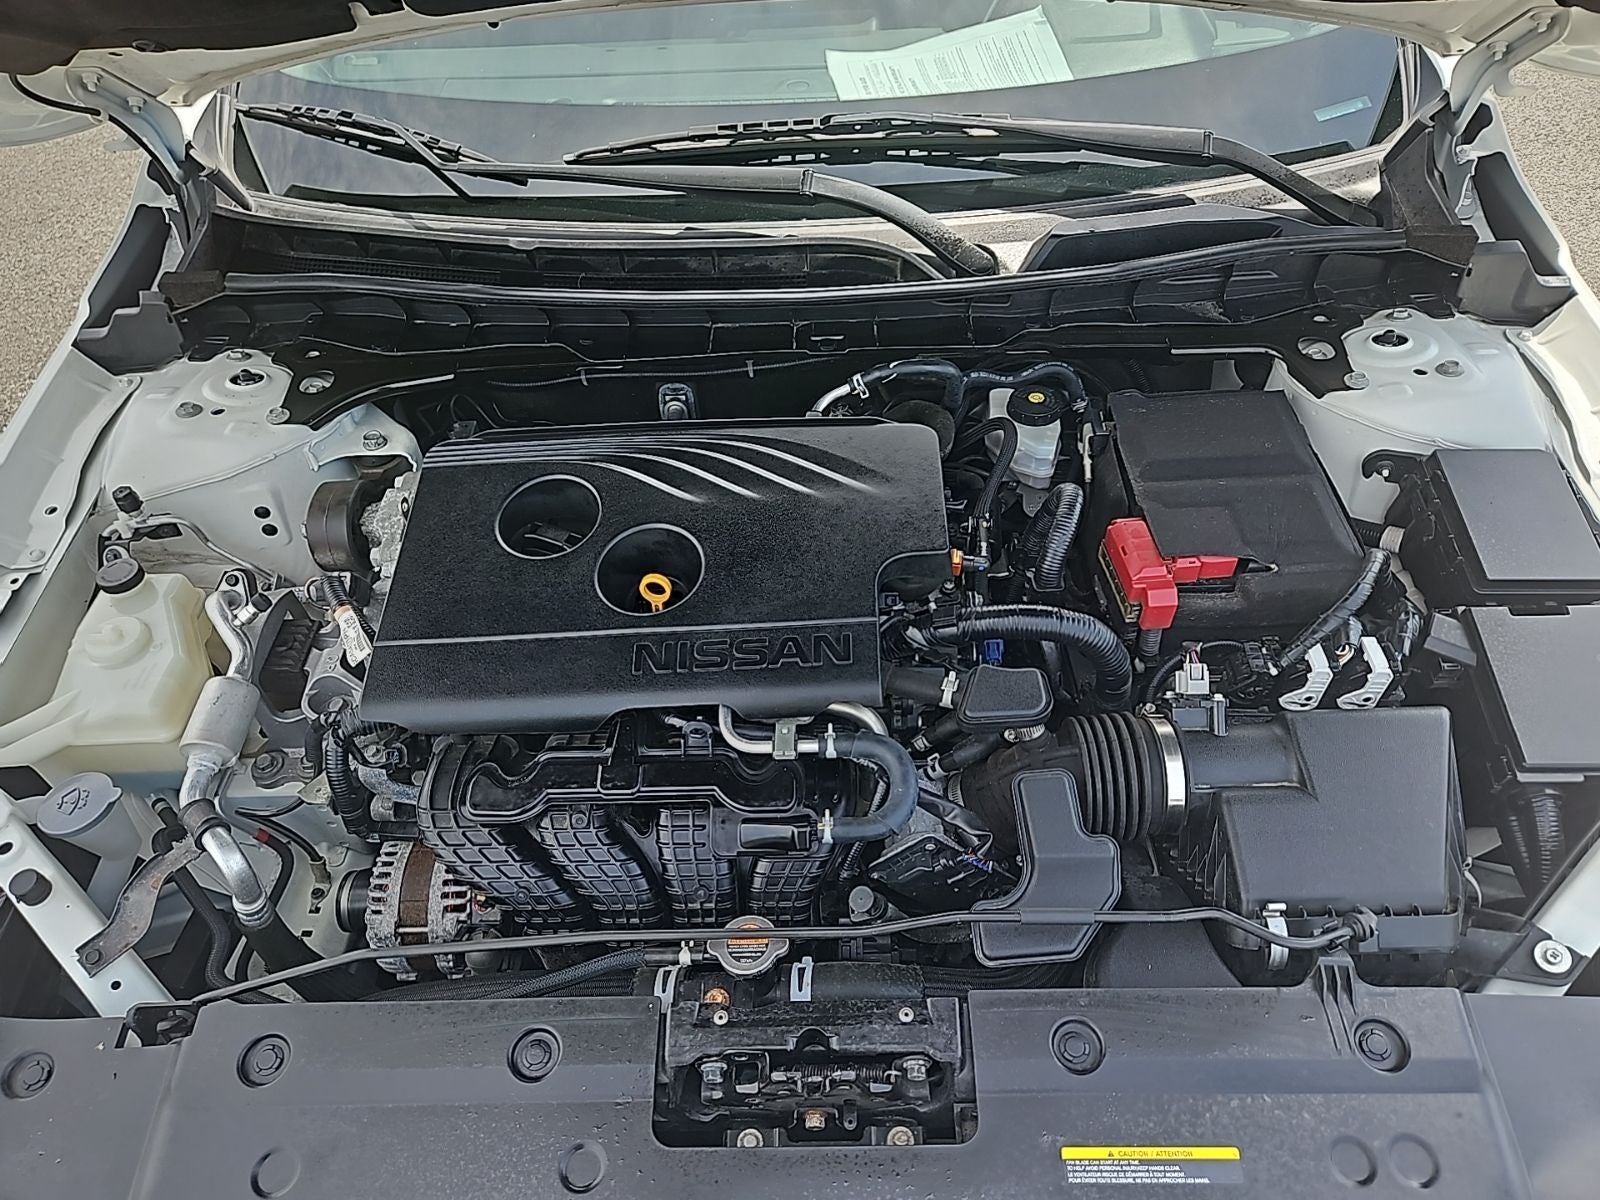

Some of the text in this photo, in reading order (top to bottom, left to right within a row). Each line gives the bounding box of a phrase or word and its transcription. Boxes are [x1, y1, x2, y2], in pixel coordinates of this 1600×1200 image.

[632, 632, 852, 675] NISSAN
[1118, 1150, 1149, 1158] CAUTION
[1156, 1150, 1193, 1158] ATTENTION
